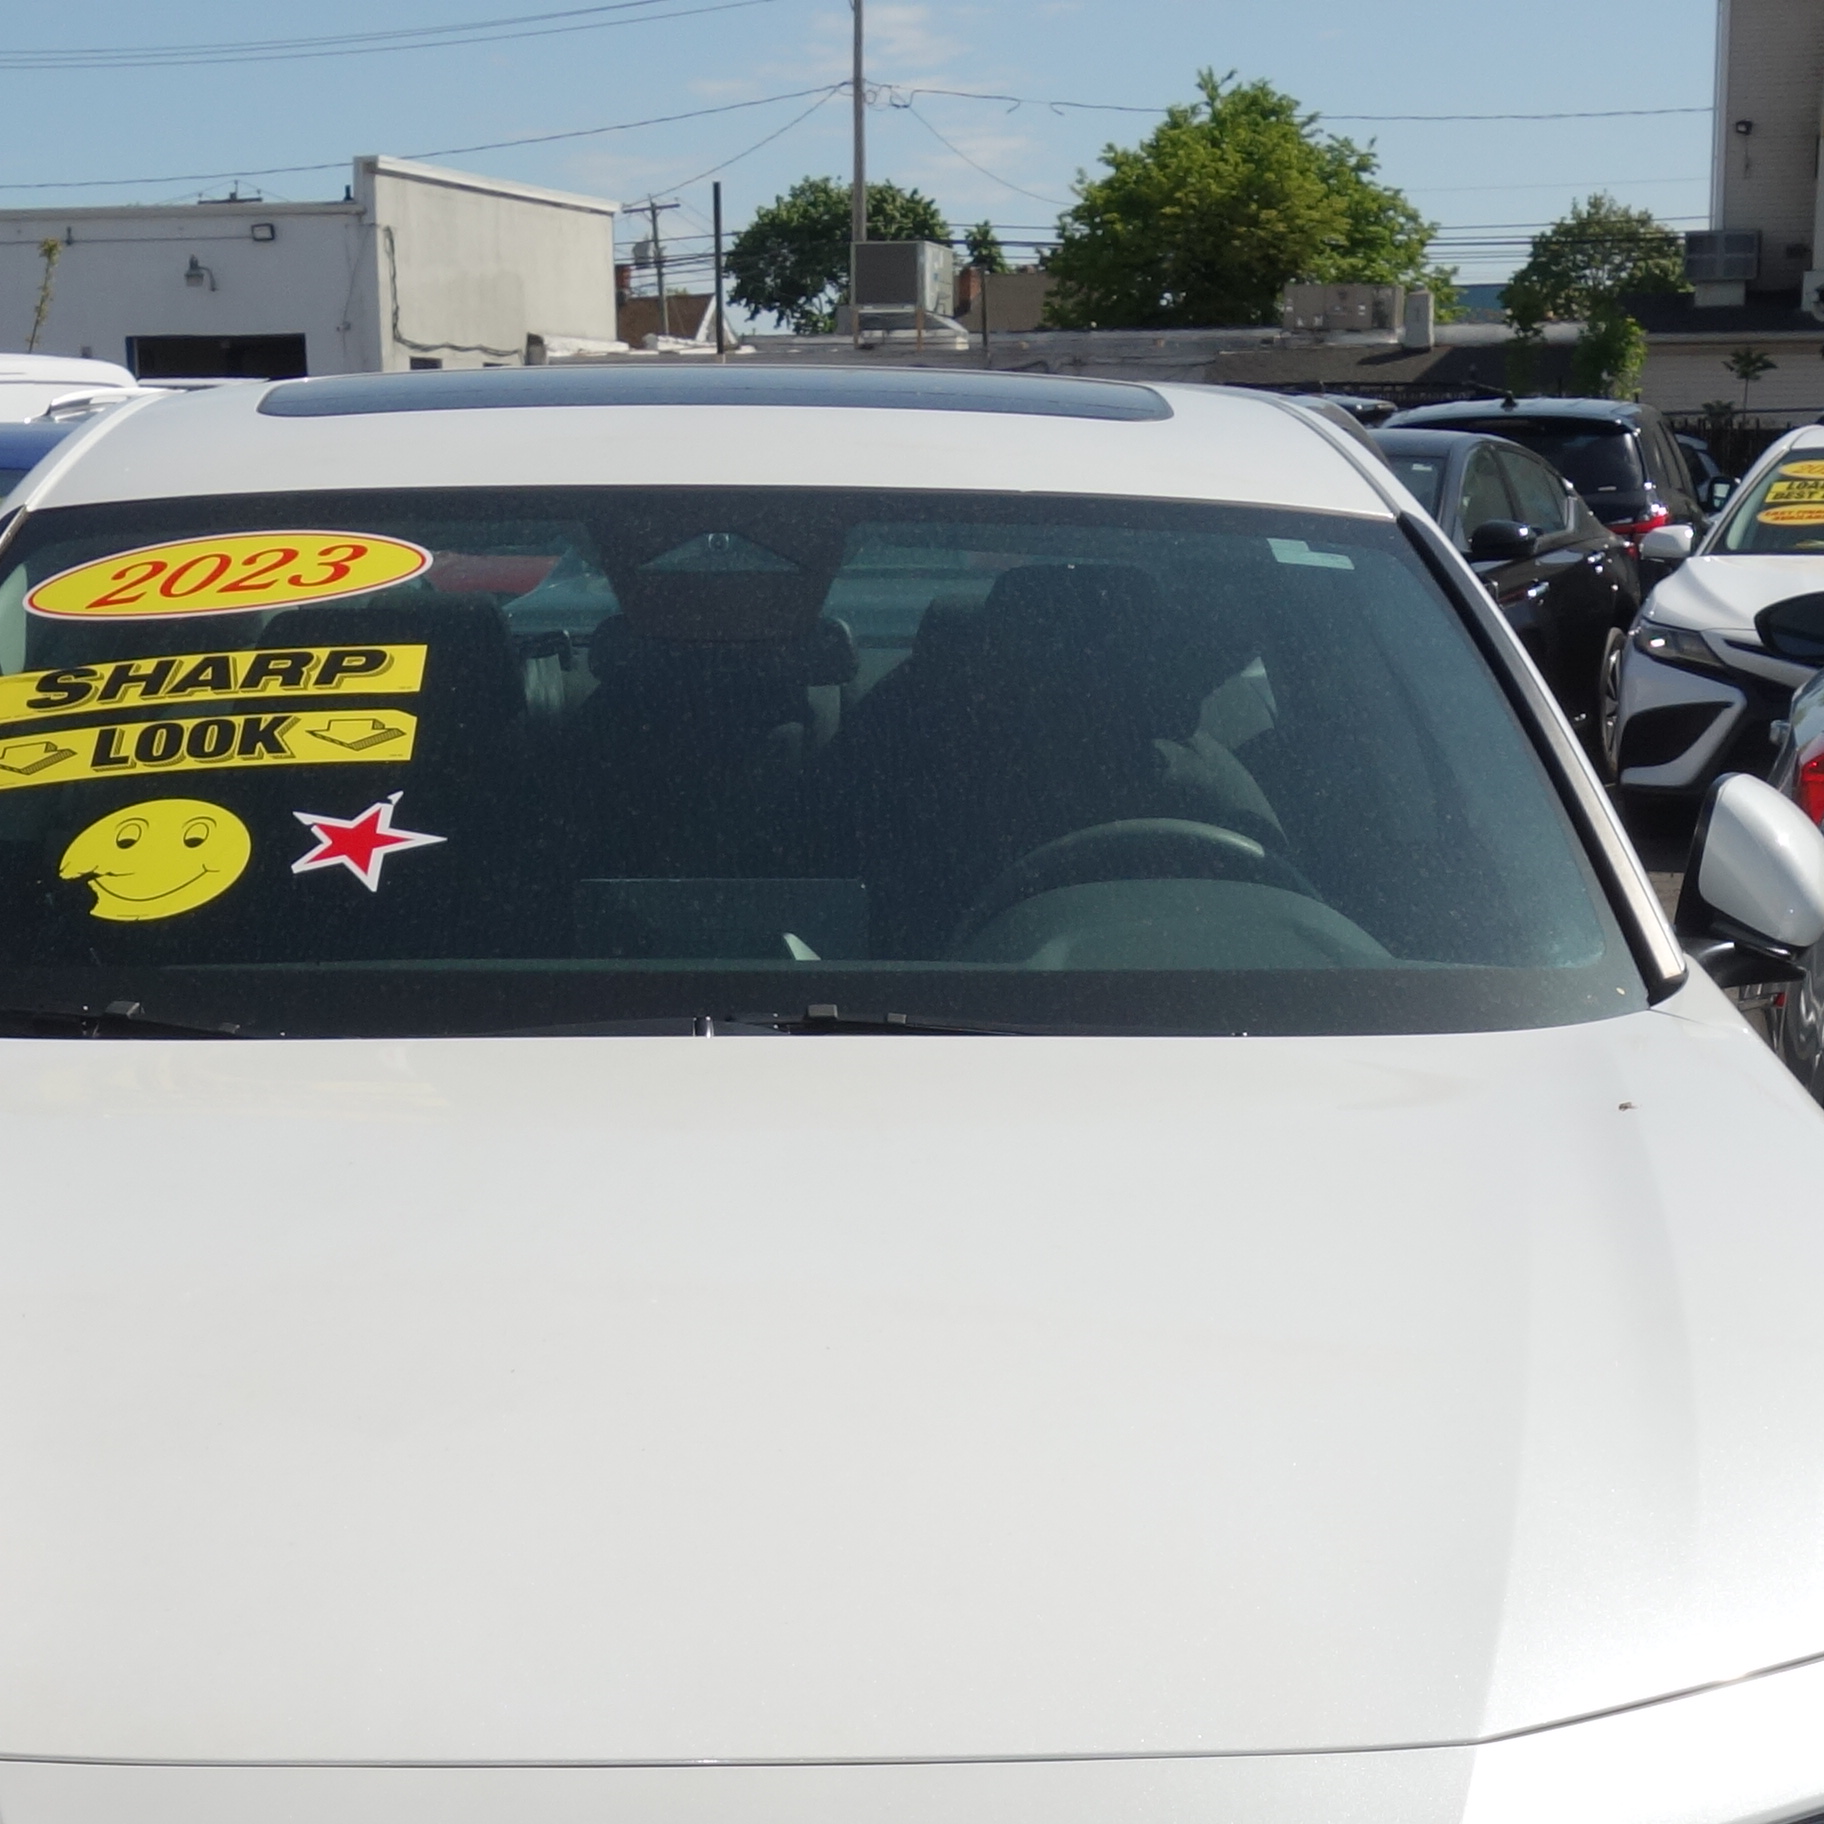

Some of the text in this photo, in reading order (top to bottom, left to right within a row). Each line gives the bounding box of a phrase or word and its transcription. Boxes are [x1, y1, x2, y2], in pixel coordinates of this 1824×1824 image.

[1772, 490, 1818, 500] BEST
[86, 544, 369, 610] 2023
[26, 648, 390, 709] SHARP
[91, 715, 298, 772] LOOK
